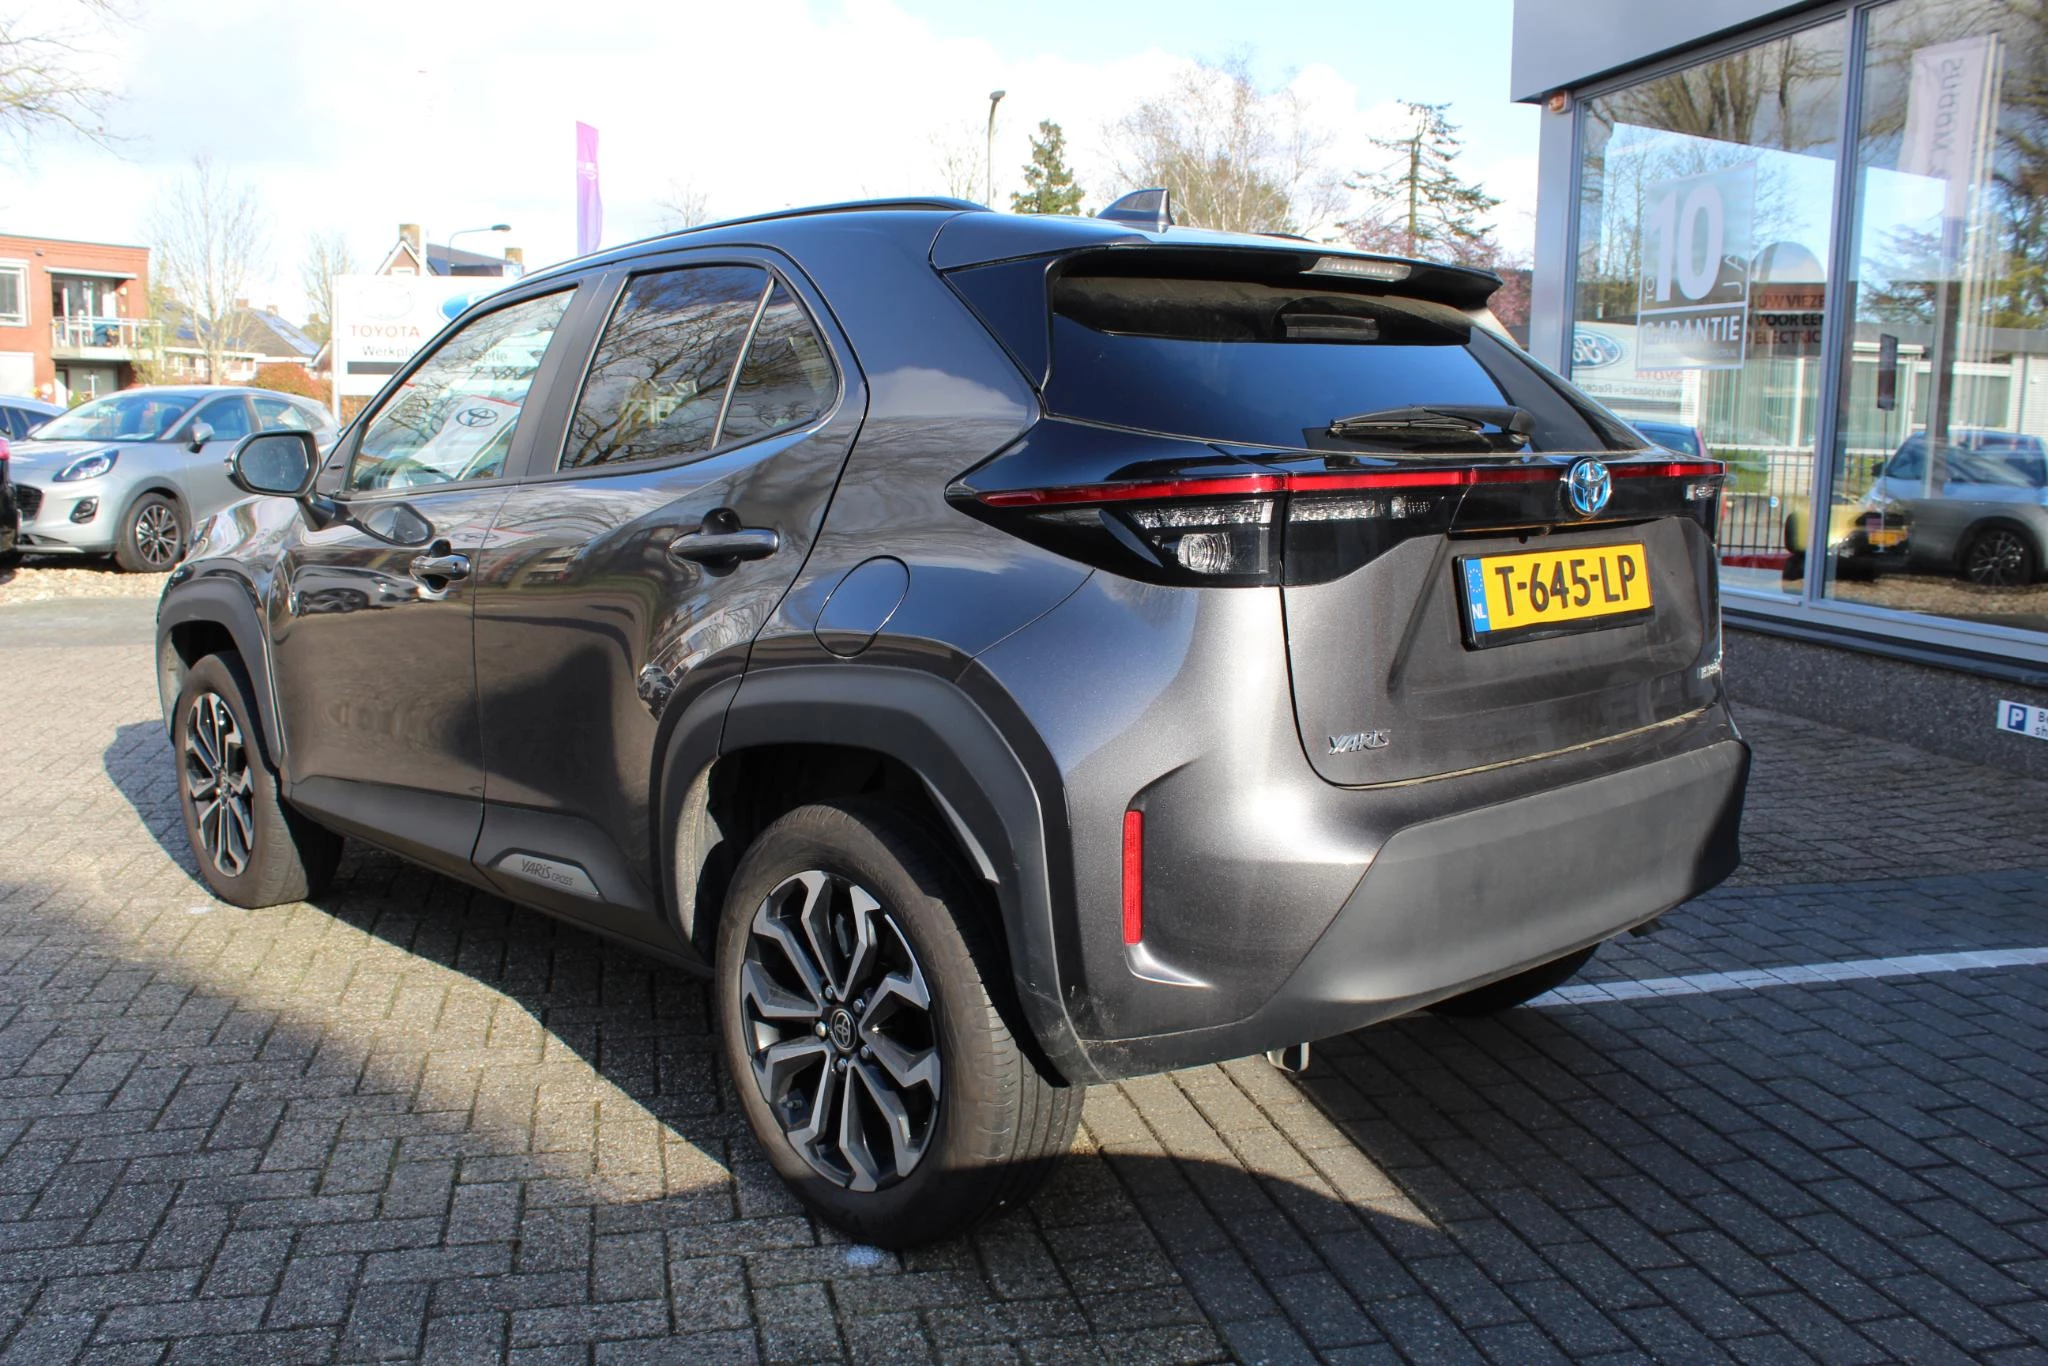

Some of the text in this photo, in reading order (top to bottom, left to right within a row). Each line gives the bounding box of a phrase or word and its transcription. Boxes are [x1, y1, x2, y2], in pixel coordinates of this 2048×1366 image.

[1651, 184, 1724, 301] 10
[350, 324, 421, 339] TOYOTA
[1643, 315, 1741, 346] GARANTIE
[1494, 554, 1636, 617] T-645-LP
[1471, 603, 1488, 620] NL
[2010, 707, 2025, 728] P
